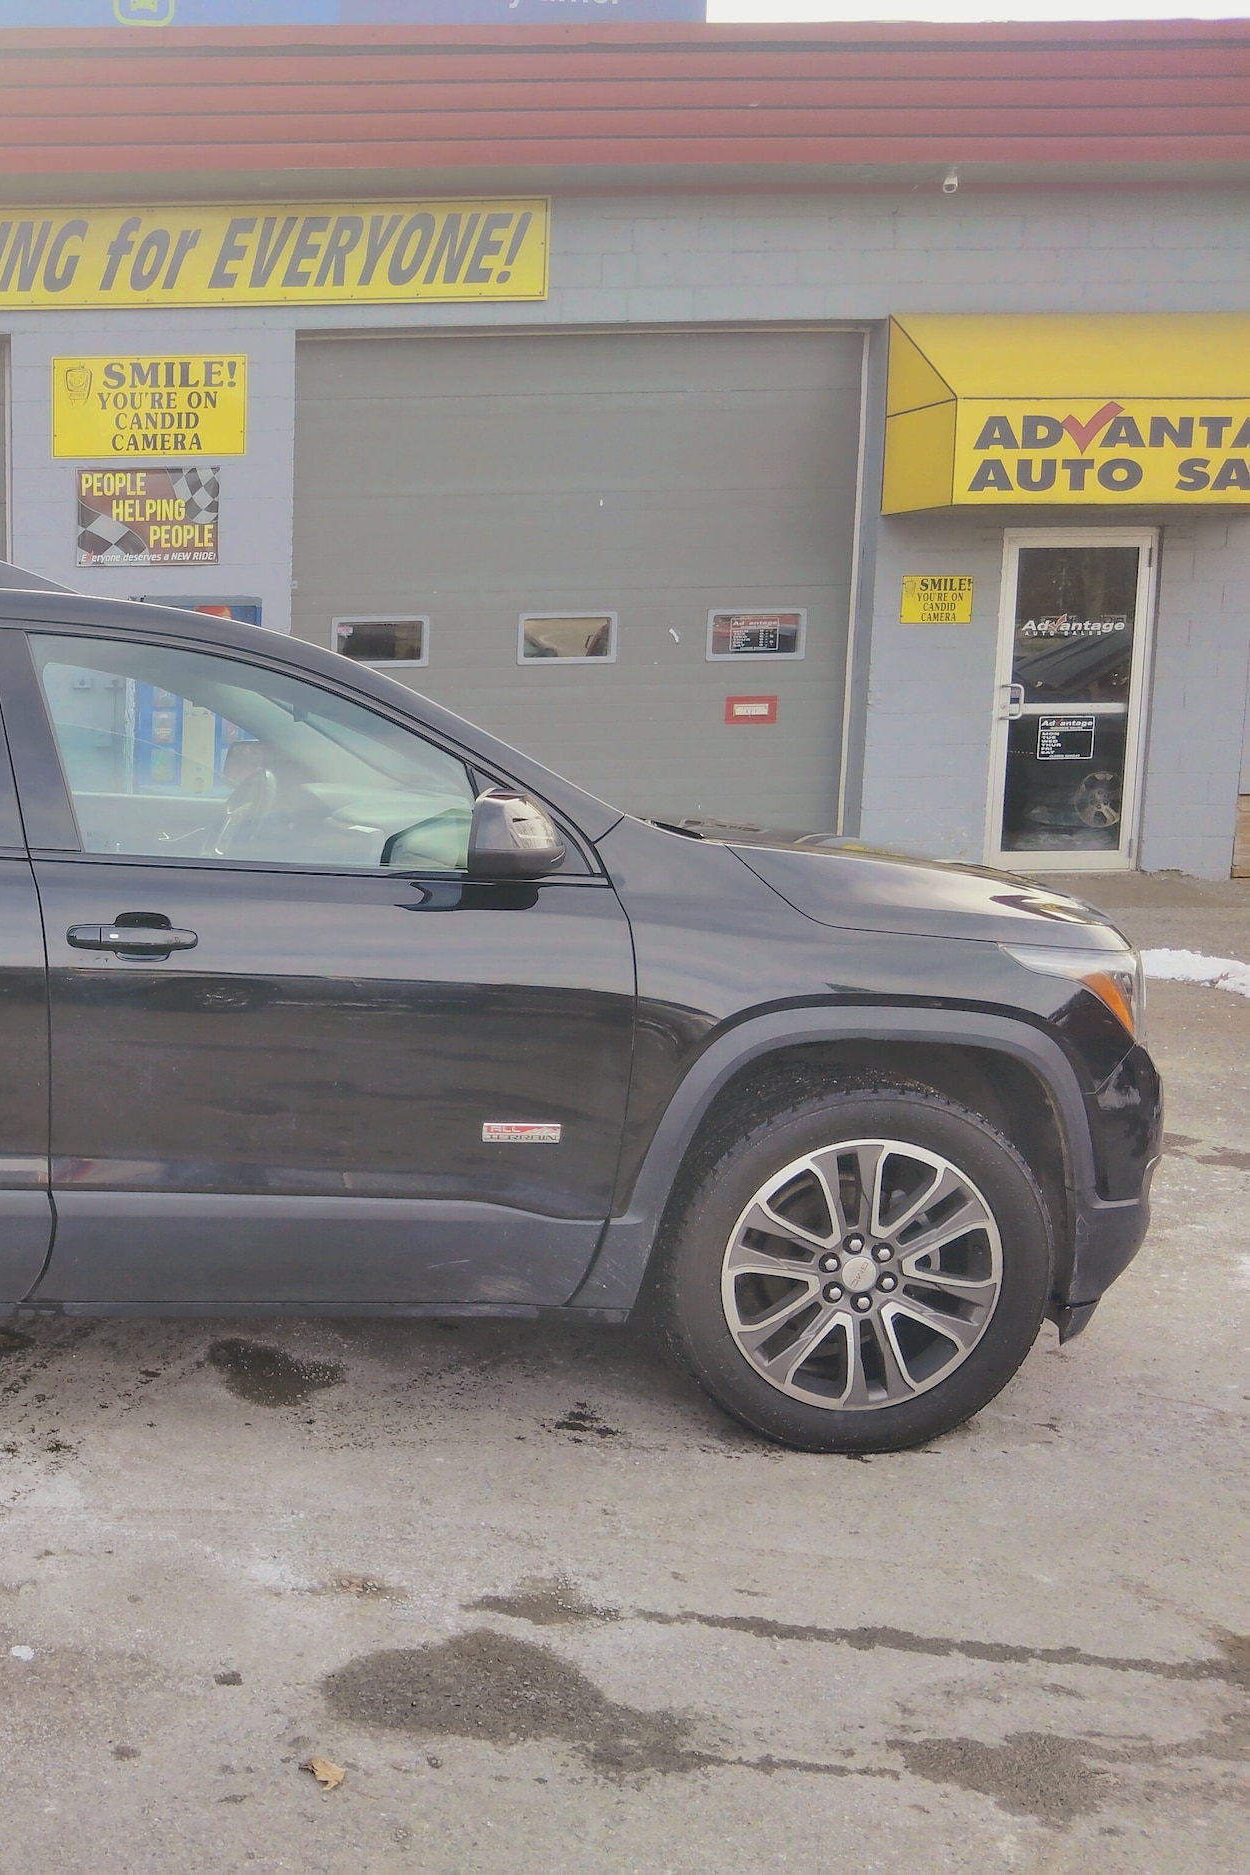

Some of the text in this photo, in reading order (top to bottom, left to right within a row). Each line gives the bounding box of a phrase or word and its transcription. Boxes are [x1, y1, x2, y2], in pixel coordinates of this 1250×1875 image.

[98, 216, 202, 292] for
[206, 211, 533, 289] EVERYONE!
[102, 360, 237, 390] SMILE!
[97, 391, 218, 410] YOU'RE ON
[114, 411, 200, 430] CANDID
[111, 433, 203, 451] CAMERA
[967, 457, 1144, 492] AUTO
[81, 472, 147, 497] PEOPLE
[112, 498, 186, 522] HELPING
[149, 524, 214, 548] PEOPLE
[123, 552, 162, 561] deserves
[171, 552, 192, 561] NEW
[920, 578, 972, 592] SMILE!
[951, 592, 964, 602] ON
[923, 602, 956, 612] CANDID
[921, 612, 957, 622] CAMERA
